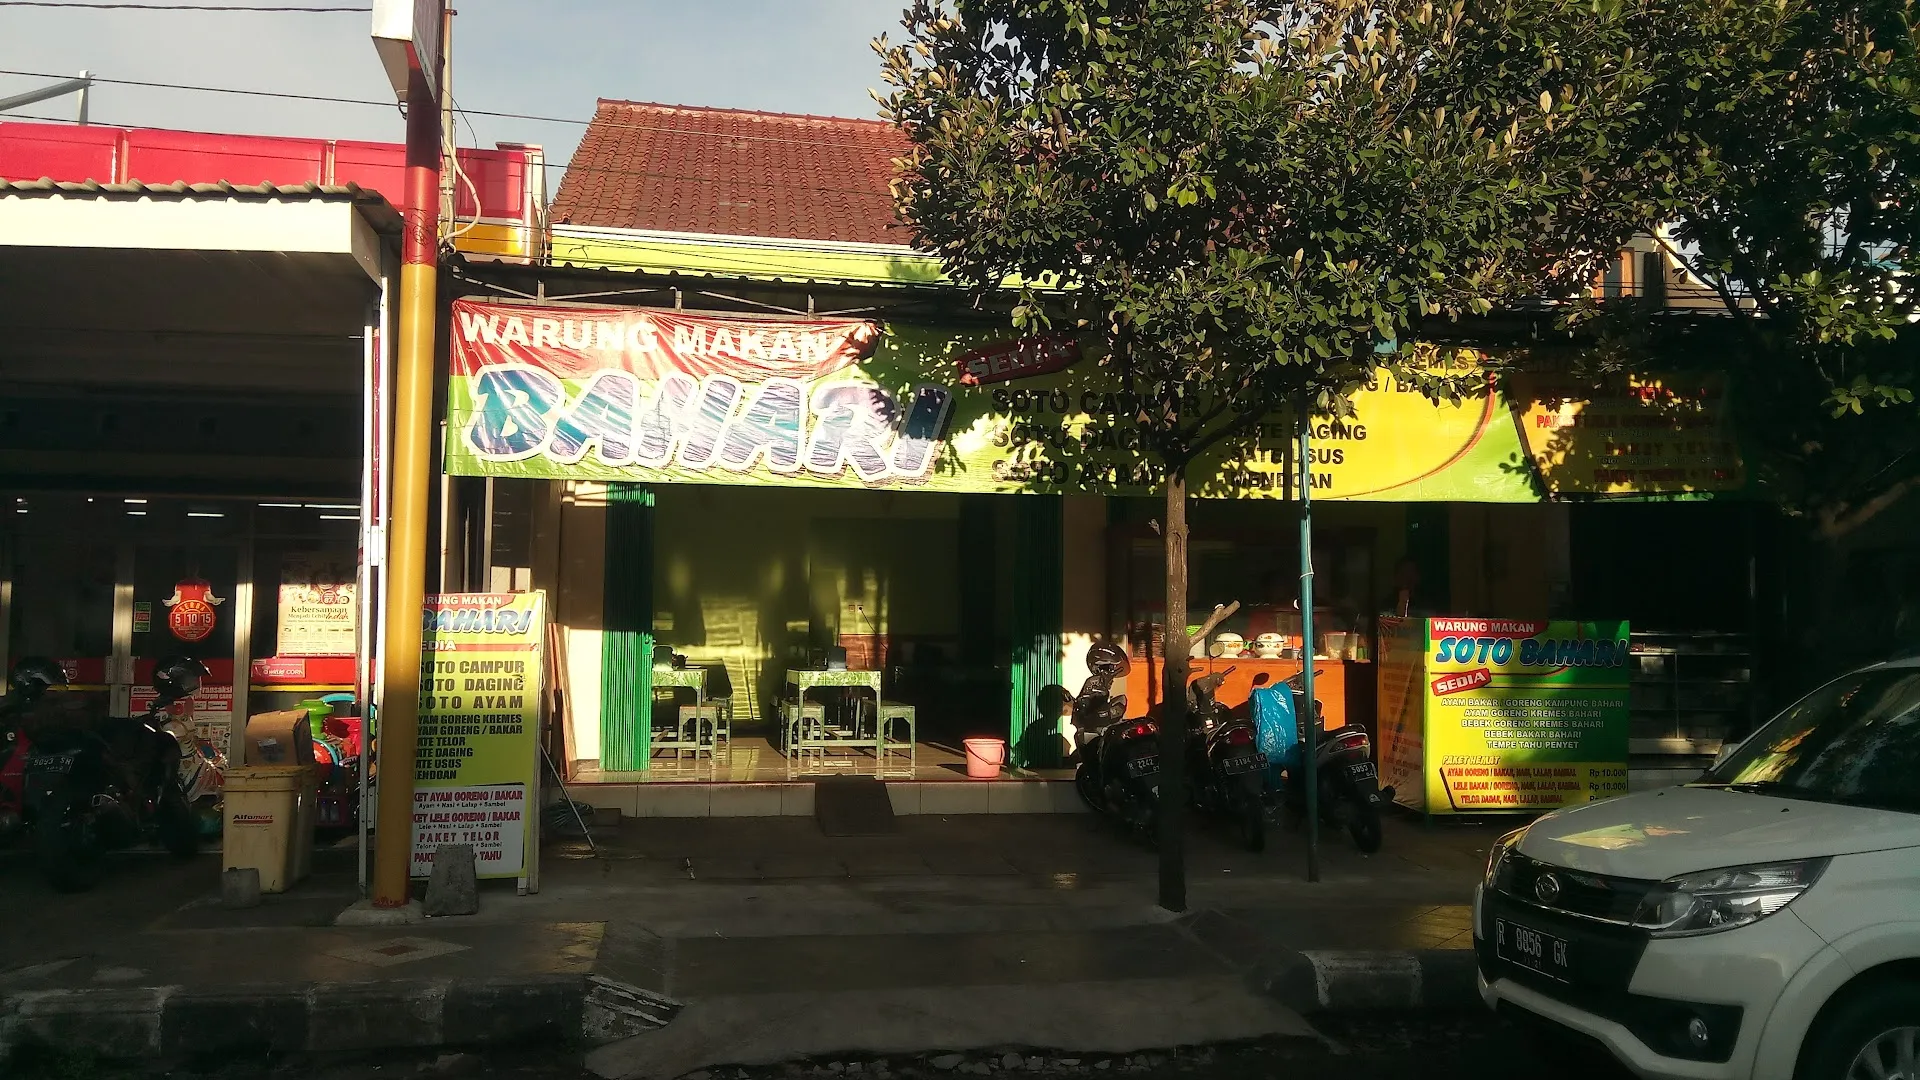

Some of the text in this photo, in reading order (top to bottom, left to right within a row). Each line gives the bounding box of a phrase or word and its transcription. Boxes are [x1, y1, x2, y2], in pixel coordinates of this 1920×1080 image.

[460, 311, 830, 362] WARUNG MAKAN
[967, 338, 1072, 378] SEDIA
[991, 389, 1070, 414] SOTO
[1079, 391, 1202, 417] CAPR
[468, 363, 954, 488] BAHARI
[992, 424, 1070, 449] SOTO
[1292, 423, 1367, 440] AGING
[991, 460, 1070, 485] SOTO
[461, 595, 502, 605] MAKAN
[178, 601, 207, 612] SERBA
[291, 606, 347, 614] Kebersamaan
[175, 613, 212, 625] 5 10 15
[288, 613, 311, 621] Menjadi
[422, 608, 532, 637] BAHARI
[1434, 621, 1535, 633] WARUNG MAKAN
[421, 640, 457, 651] EDIA
[1435, 636, 1630, 669] SOTO BAHARI
[459, 660, 525, 674] CAMPUR
[464, 678, 524, 691] DAGING
[1436, 671, 1487, 694] SEDIA
[473, 695, 523, 709] AYAM
[1441, 698, 1624, 708] AYAM BAKAR GORENG KAMPUNG BAHARI
[418, 713, 523, 724] YAM GORENG KREMES
[1464, 709, 1601, 718] AYAM GORENG KREMES BAHARI
[1461, 720, 1605, 728] BEBEK GORENG KREMES BAHARI
[417, 724, 523, 736] YAM GORENG / BAKAR
[1484, 730, 1582, 739] BEBEK BAKAR BAHARI
[417, 736, 466, 747] ATE TELOR
[1486, 741, 1580, 749] TEMPE TAHU PENYET
[415, 747, 474, 758] ATE DAGING
[415, 758, 462, 769] ATE USUS
[1224, 760, 1231, 768] R
[1442, 755, 1501, 765] PAKET HEMAT
[414, 769, 457, 780] ENDOAN
[1447, 768, 1464, 777] AYAM
[1464, 768, 1489, 777] GORENG
[1589, 768, 1627, 778] Rp 10.000
[1453, 781, 1468, 790] LELE
[1469, 781, 1489, 790] BAKAR
[1589, 782, 1600, 792] Rp
[429, 792, 453, 802] AYAM
[454, 791, 489, 801] GORENG
[494, 790, 523, 801] BAKAR
[1460, 795, 1481, 804] TELOR
[461, 801, 478, 809] Lalap
[429, 813, 450, 823] LELE
[451, 812, 487, 822] GORENG
[492, 811, 520, 821] BAKAR
[419, 831, 500, 843] PAKET TELOR
[480, 851, 502, 861] TAHU
[1498, 921, 1568, 968] R 8856 GK
